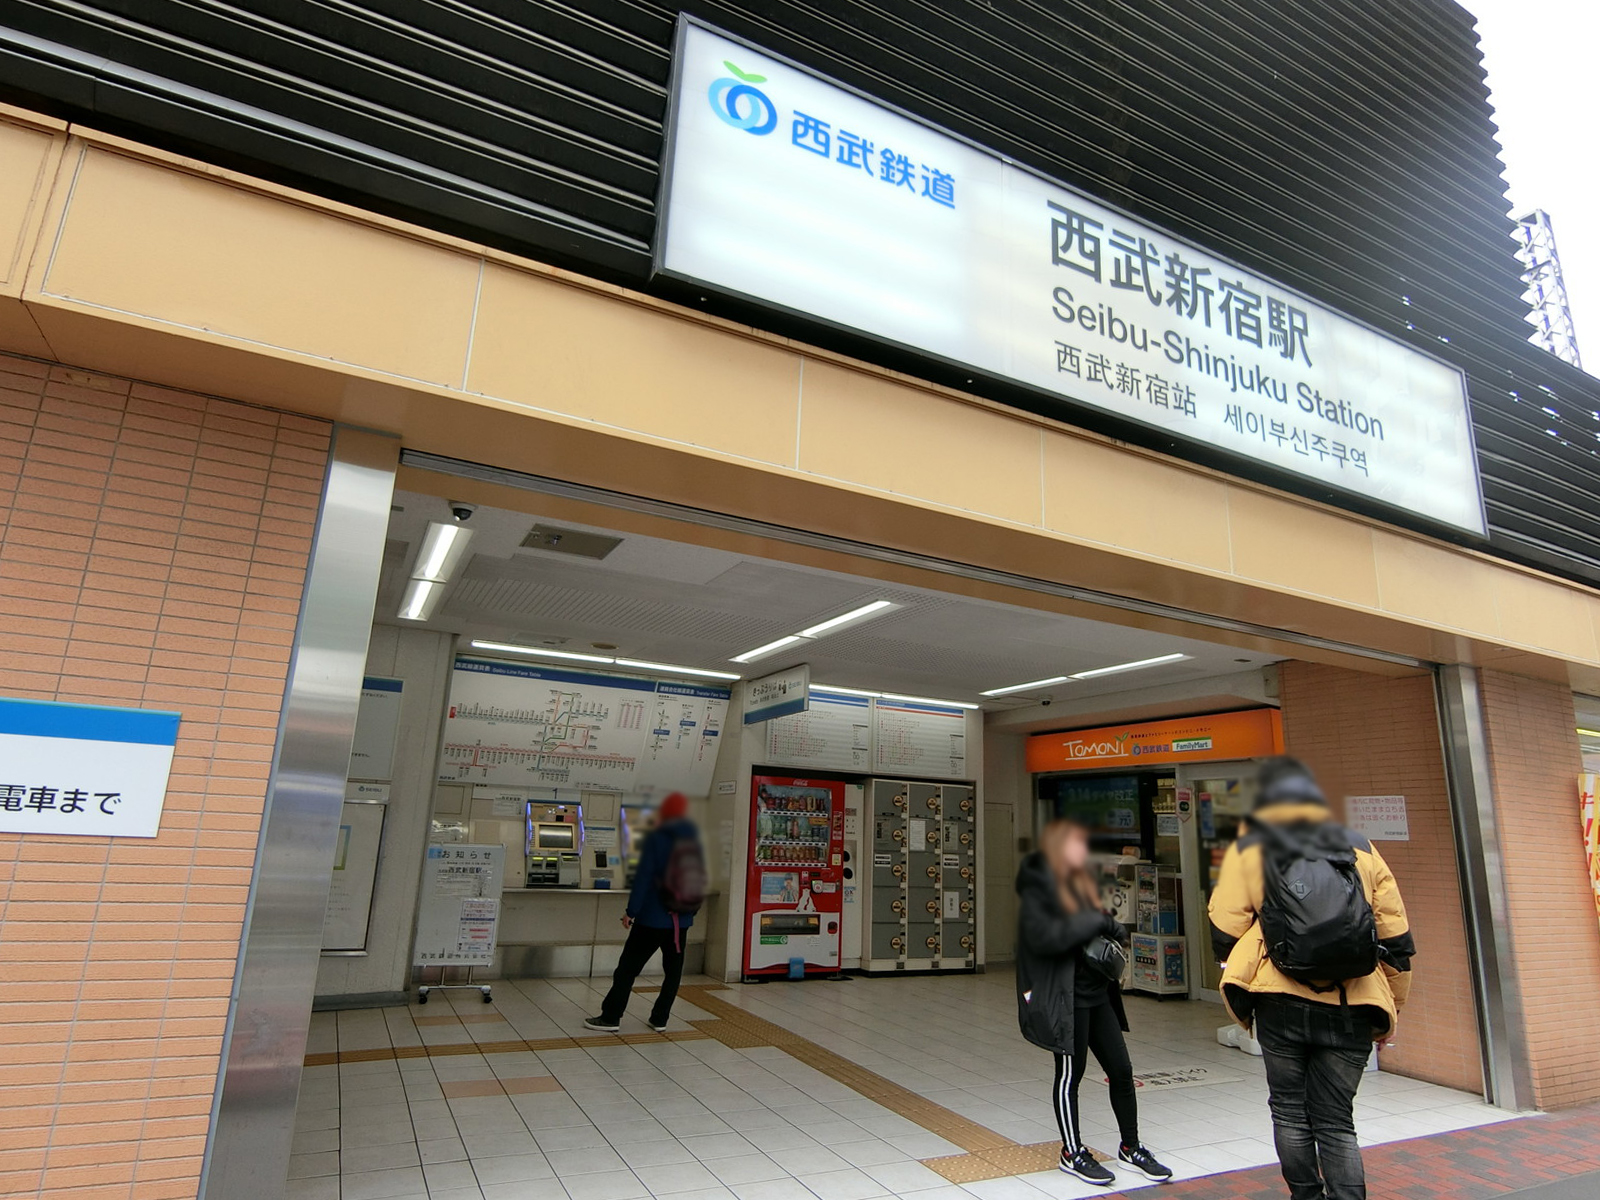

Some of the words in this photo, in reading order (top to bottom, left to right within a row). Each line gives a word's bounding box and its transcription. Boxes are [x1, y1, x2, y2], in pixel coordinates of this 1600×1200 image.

[791, 109, 956, 209] 西武鉄道
[1047, 199, 1313, 368] 西武新宿駅
[1052, 286, 1288, 405] Seibu-Shinjuku
[1296, 381, 1385, 441] Station
[1054, 340, 1198, 419] 西武新宿站
[1223, 402, 1370, 477] 세이부신주쿠역
[1176, 740, 1209, 752] FamilyMart
[0, 784, 122, 815] 電車まで
[552, 787, 558, 799] 1
[441, 850, 491, 860] お知らせ
